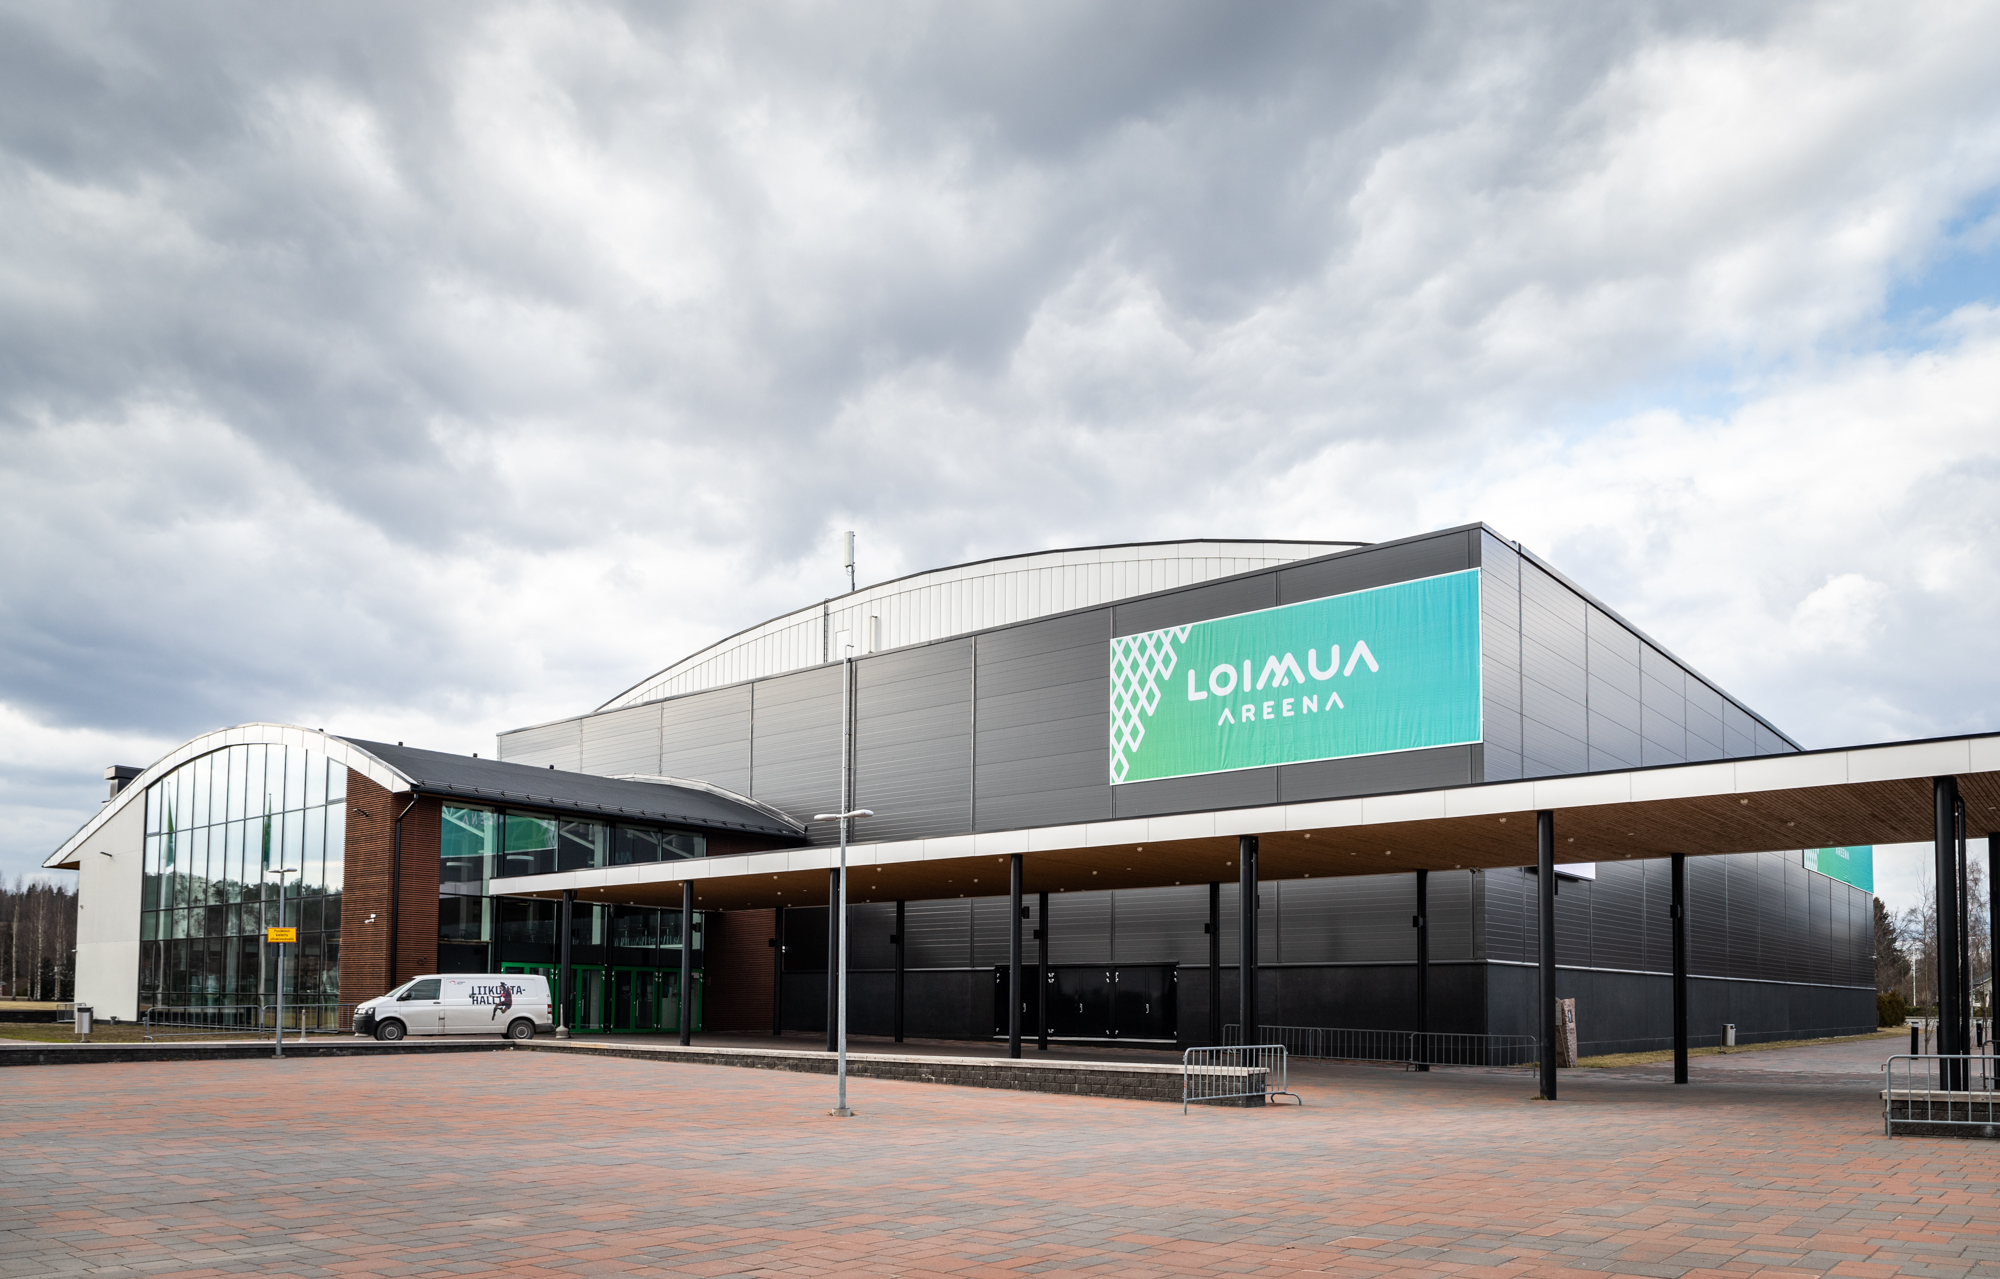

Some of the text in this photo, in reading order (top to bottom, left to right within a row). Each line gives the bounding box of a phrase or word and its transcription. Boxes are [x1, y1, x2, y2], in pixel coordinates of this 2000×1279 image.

[1187, 640, 1380, 701] LOIMUA
[1217, 691, 1344, 726] AREENA
[471, 985, 526, 995] LIIKUTA-
